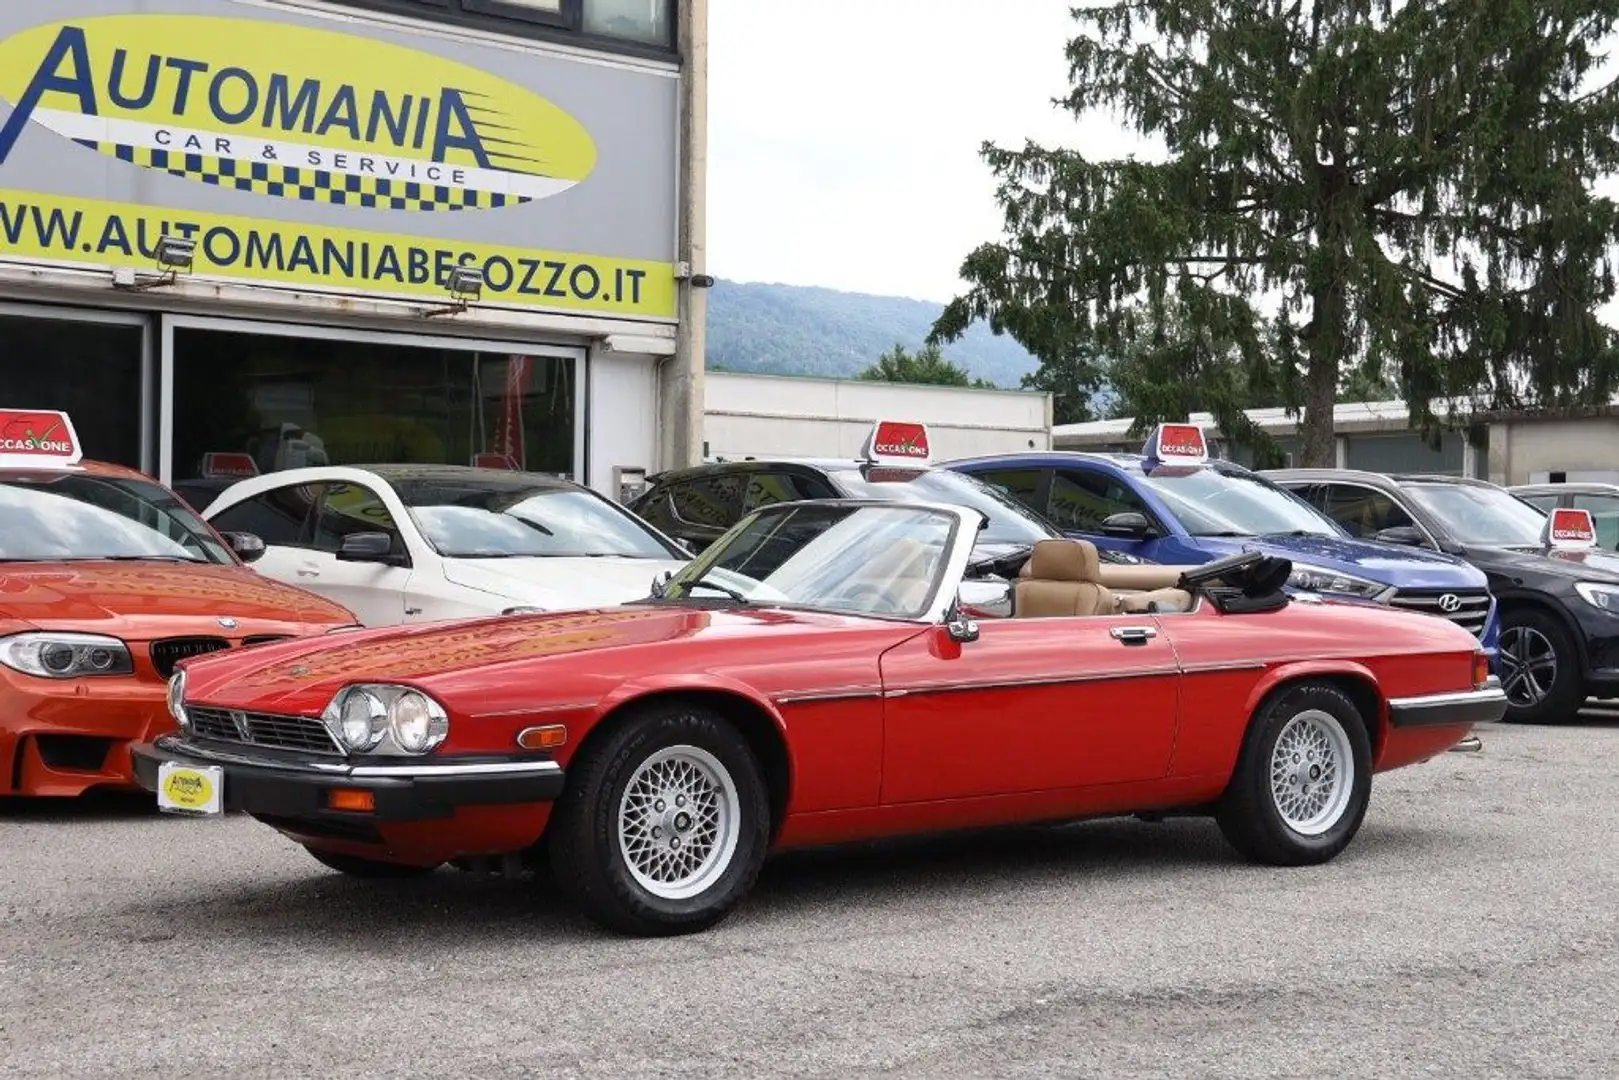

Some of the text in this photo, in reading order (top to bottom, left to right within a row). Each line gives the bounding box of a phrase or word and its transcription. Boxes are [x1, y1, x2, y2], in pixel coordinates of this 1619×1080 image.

[0, 26, 494, 169] AUTOMANIA
[155, 129, 466, 184] CAR & SERVICE
